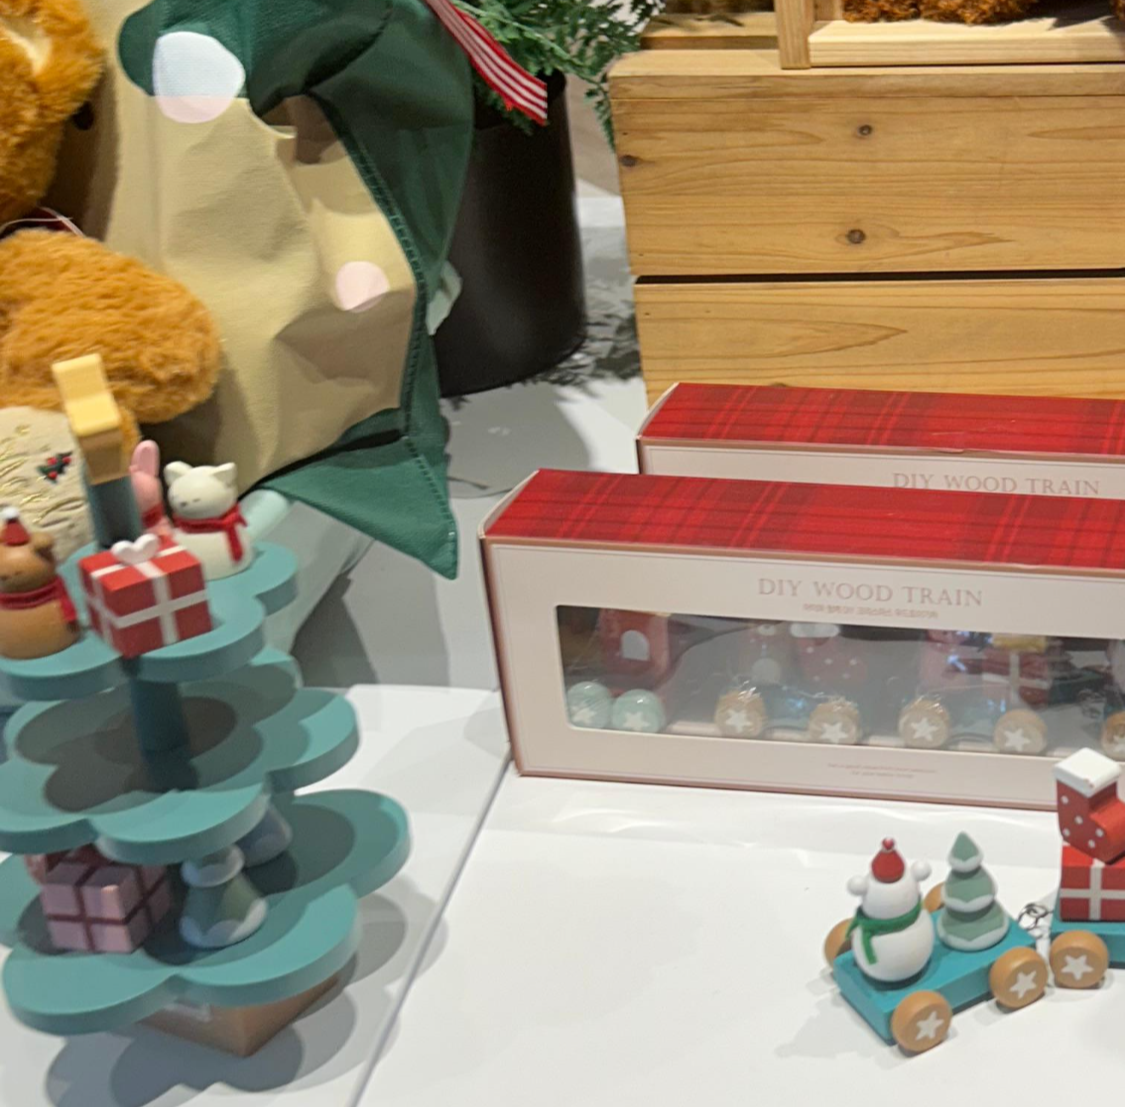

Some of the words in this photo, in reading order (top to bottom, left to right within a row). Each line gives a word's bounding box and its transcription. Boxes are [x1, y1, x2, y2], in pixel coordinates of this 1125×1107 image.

[891, 472, 935, 489] DIY
[943, 473, 1018, 494] WOOD
[1025, 477, 1101, 496] TRAIN
[758, 578, 803, 598] DIY
[813, 580, 894, 603] WOOD
[901, 585, 983, 608] TRAIN
